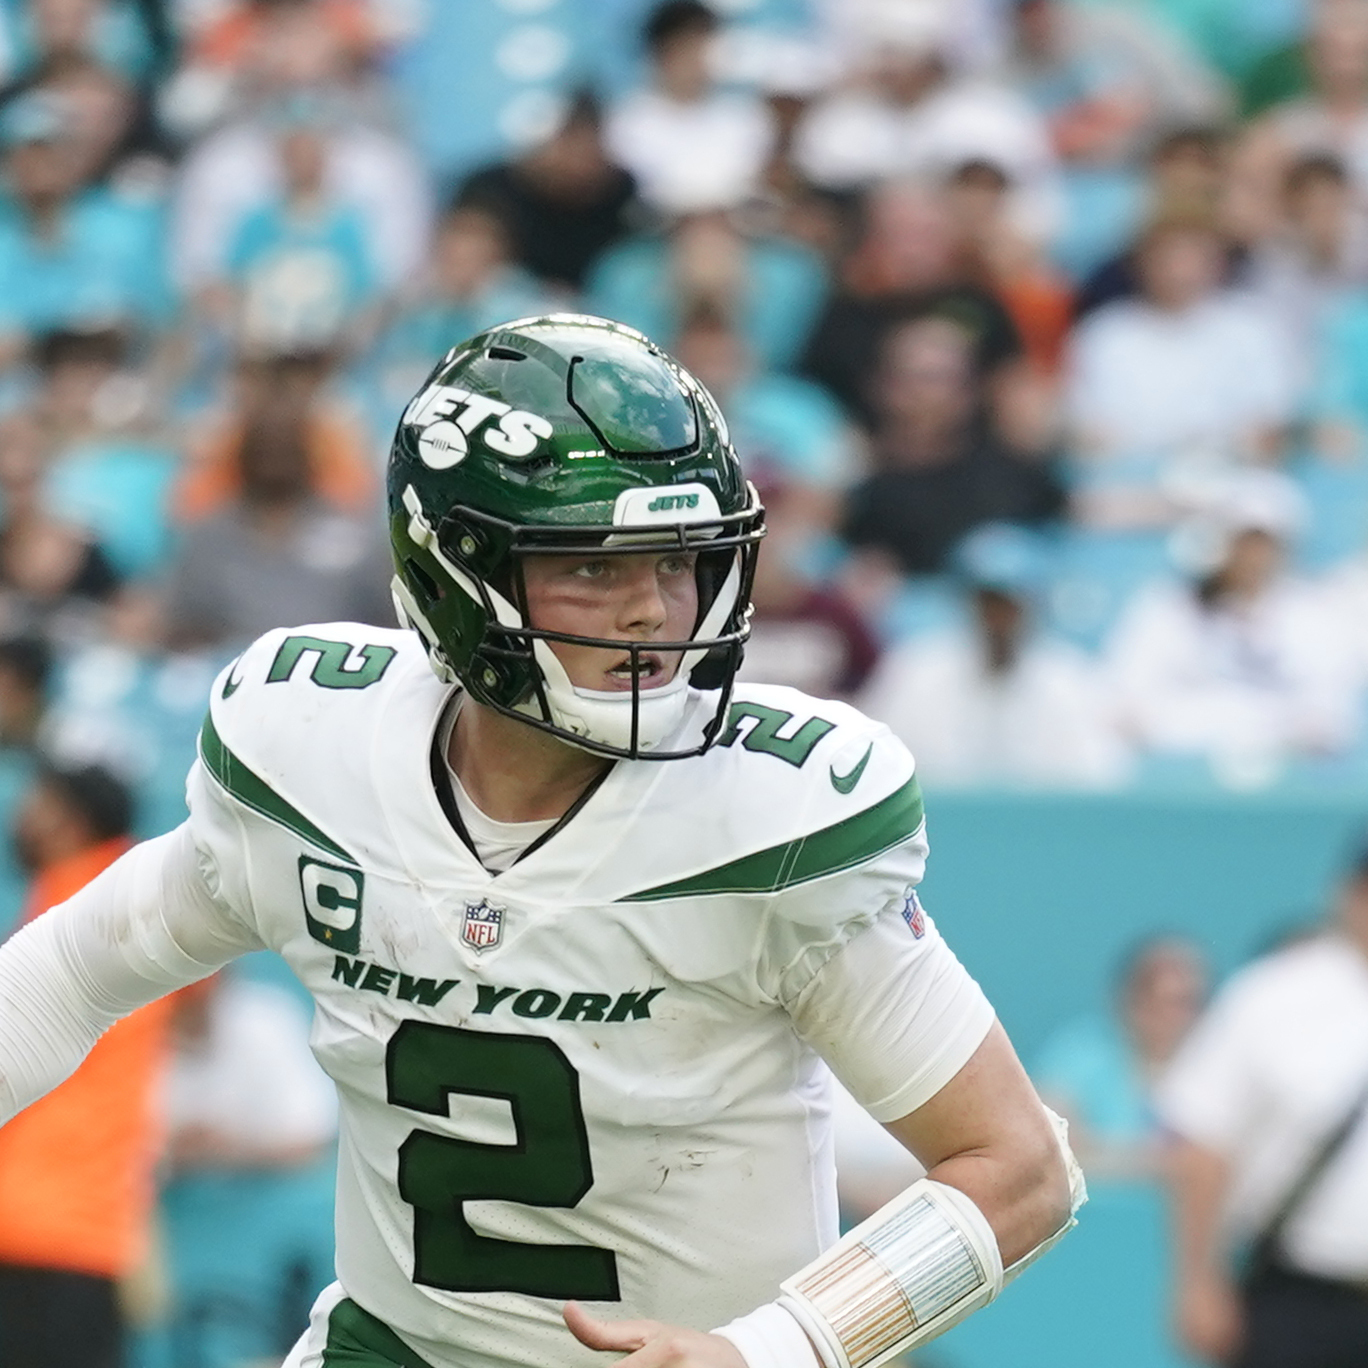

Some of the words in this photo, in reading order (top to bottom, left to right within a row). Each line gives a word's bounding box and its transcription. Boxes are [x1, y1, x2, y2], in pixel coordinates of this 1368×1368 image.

[402, 383, 554, 457] JETS
[648, 493, 699, 512] JETS
[265, 635, 399, 690] 2
[715, 700, 838, 769] 2
[301, 862, 359, 932] C
[466, 922, 496, 945] NFL
[331, 954, 461, 1008] NEW
[471, 983, 666, 1023] YORK
[385, 1018, 622, 1303] 2
